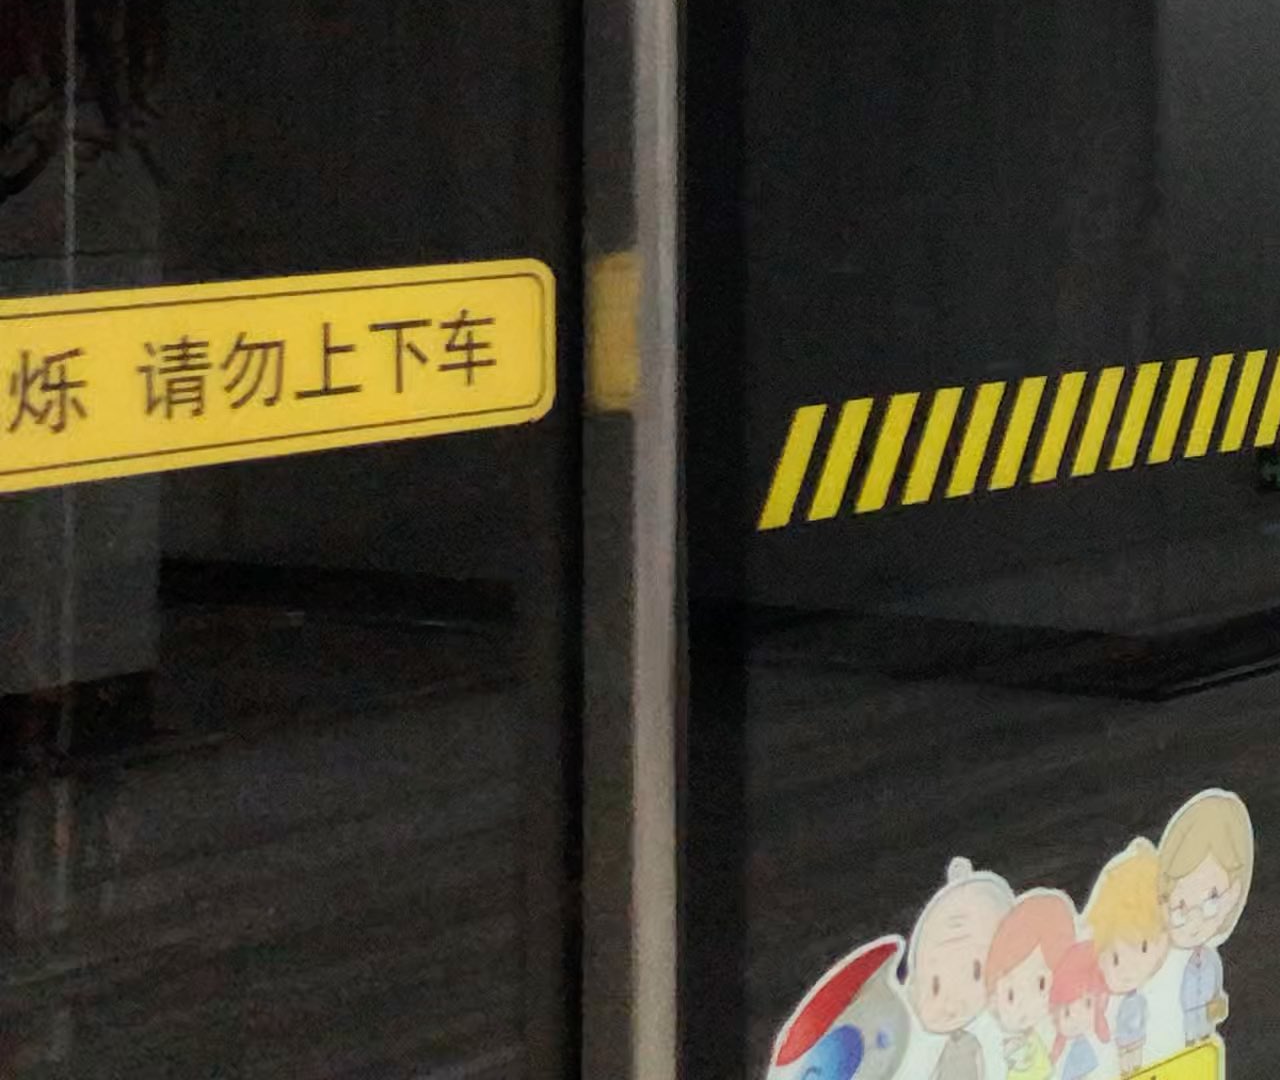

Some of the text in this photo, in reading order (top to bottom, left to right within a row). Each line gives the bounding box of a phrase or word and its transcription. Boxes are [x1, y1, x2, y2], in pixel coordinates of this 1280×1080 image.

[8, 308, 498, 433] 烁 请勿上下车
